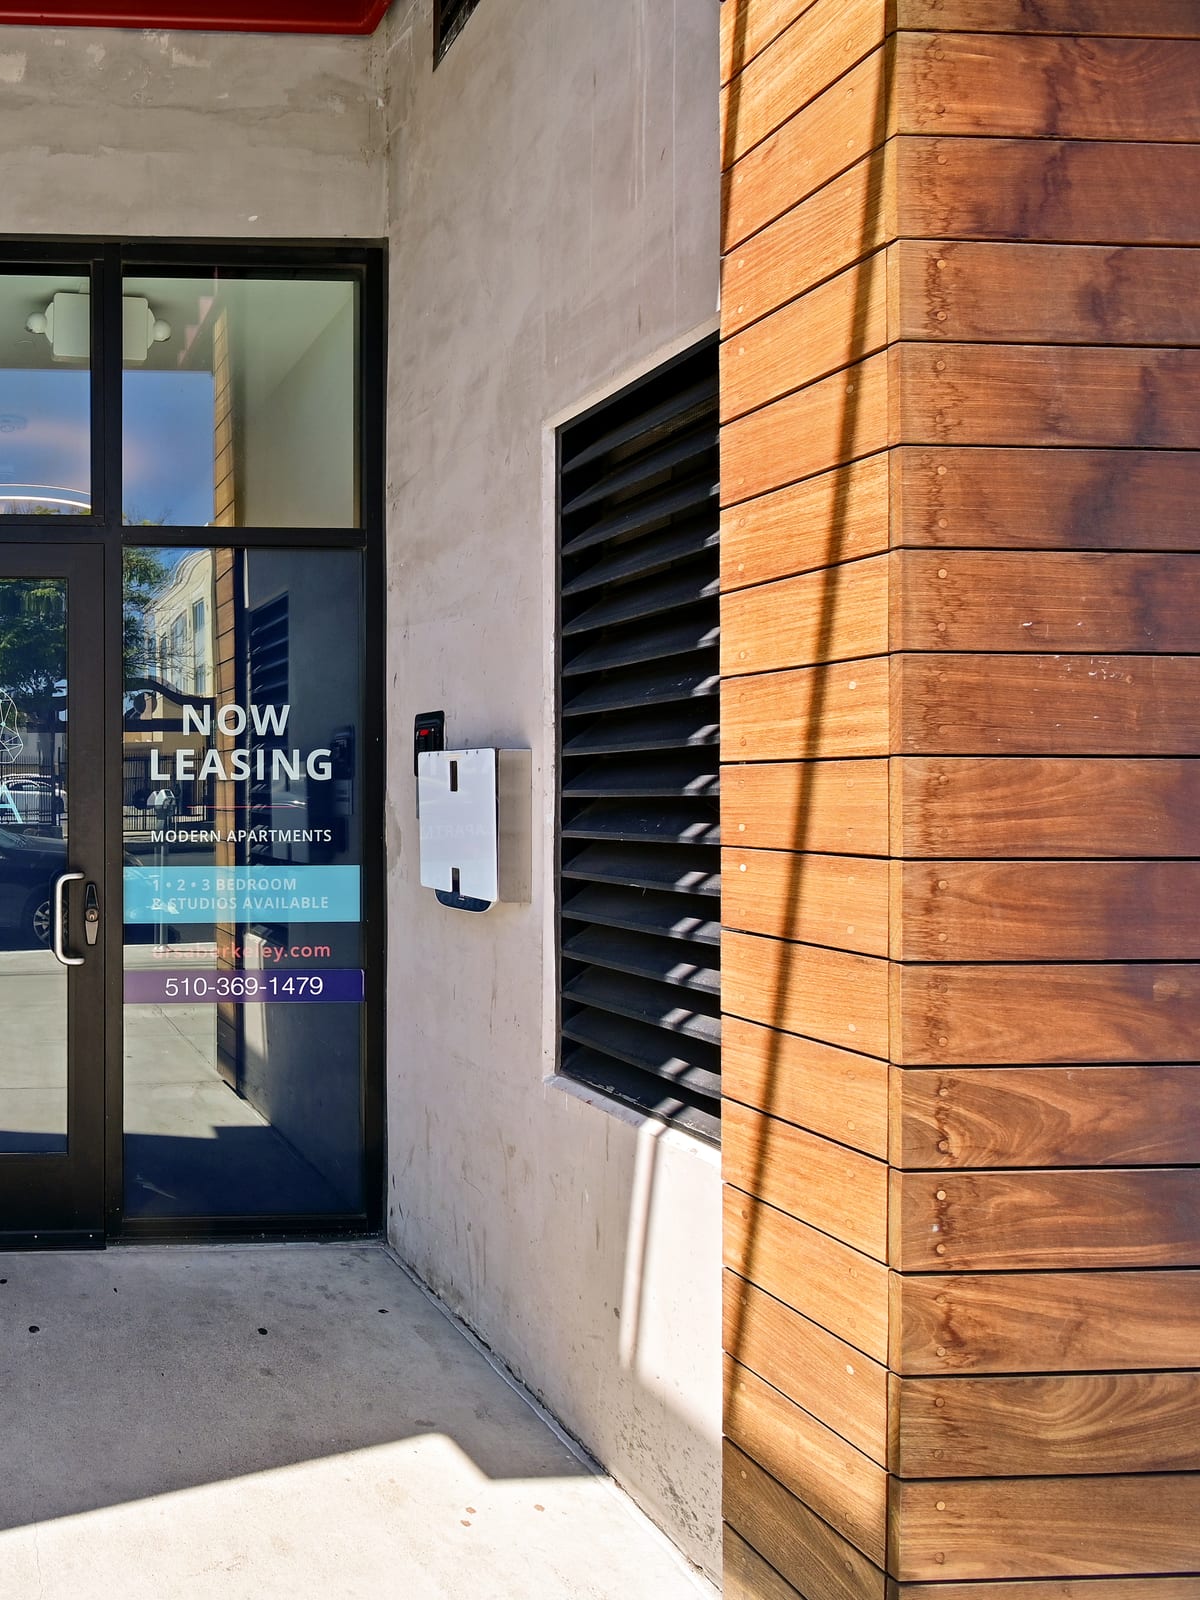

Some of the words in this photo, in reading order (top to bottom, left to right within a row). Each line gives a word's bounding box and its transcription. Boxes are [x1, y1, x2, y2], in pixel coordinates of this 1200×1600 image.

[182, 704, 291, 737] NOW
[150, 748, 334, 782] LEASING
[150, 829, 222, 844] MODERN
[226, 828, 333, 843] APARTMENTS
[152, 880, 160, 891] 1
[176, 879, 186, 891] 2
[201, 879, 211, 891] 3
[215, 878, 297, 891] BEDROOM
[151, 898, 162, 910] &
[167, 897, 238, 910] STUDIOS
[242, 896, 329, 910] AVAILABLE
[164, 976, 324, 997] 510-369-1479
